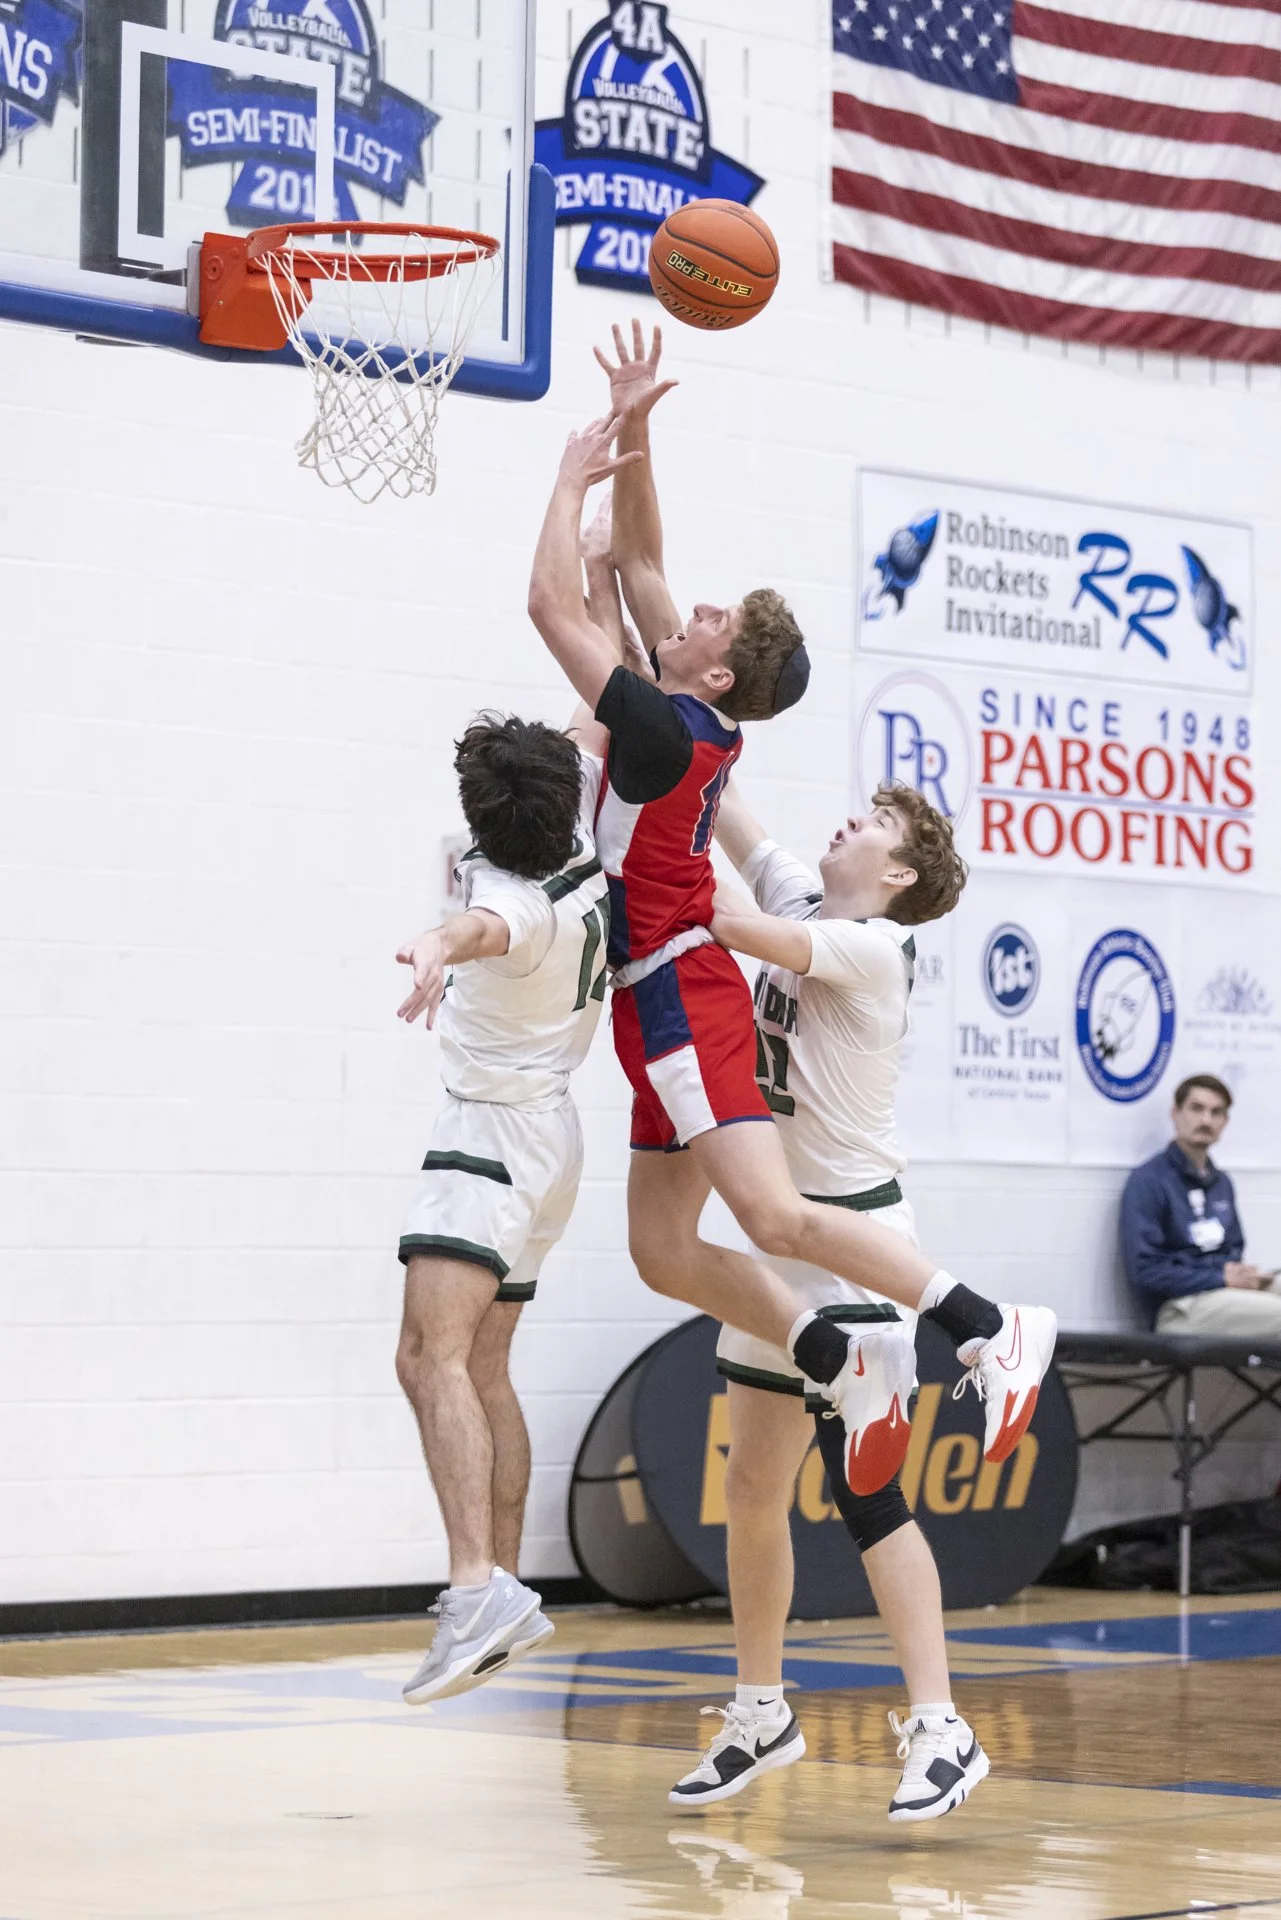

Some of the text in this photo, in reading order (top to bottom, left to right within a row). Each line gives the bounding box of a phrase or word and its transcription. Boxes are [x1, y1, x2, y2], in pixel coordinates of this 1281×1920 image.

[612, 0, 665, 54] 4A
[187, 108, 403, 184] SEMI-FINLIST
[574, 99, 704, 172] STATE
[945, 510, 1070, 560] Robinson
[946, 555, 1050, 603] Rockets
[945, 598, 1104, 651] Invitational
[980, 687, 1252, 752] SINCE 1948
[981, 729, 1255, 811] PARSONS
[981, 797, 1254, 874] ROOFING
[958, 1023, 1061, 1063] The First
[953, 1064, 1022, 1082] NATIONAL
